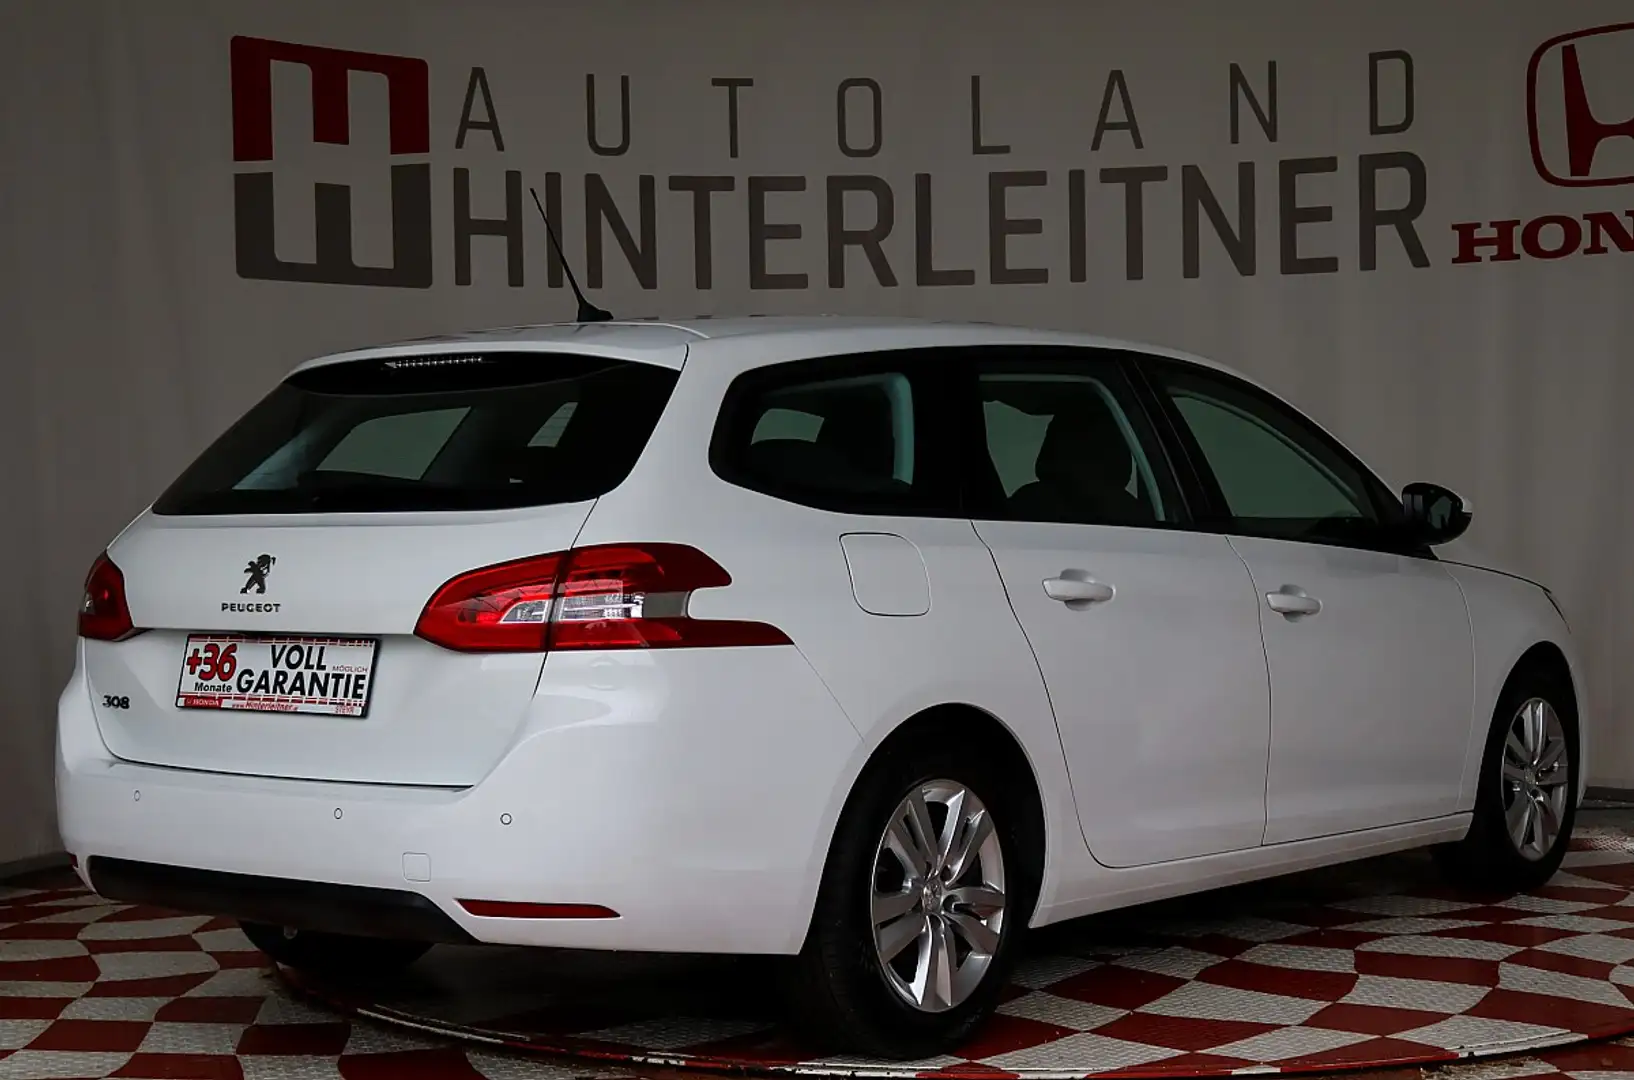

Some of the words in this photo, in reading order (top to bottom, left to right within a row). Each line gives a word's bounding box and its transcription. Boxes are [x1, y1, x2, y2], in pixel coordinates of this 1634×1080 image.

[454, 50, 1415, 158] AUTOLAND
[453, 152, 1430, 290] HINTERLEITNER
[221, 603, 281, 612] PEUGEOT
[186, 643, 238, 681] +36
[271, 644, 327, 670] VOLL
[332, 665, 368, 673] MÖGLICH
[194, 682, 232, 693] Monate
[236, 668, 366, 699] GARANTIE
[102, 695, 130, 709] 308
